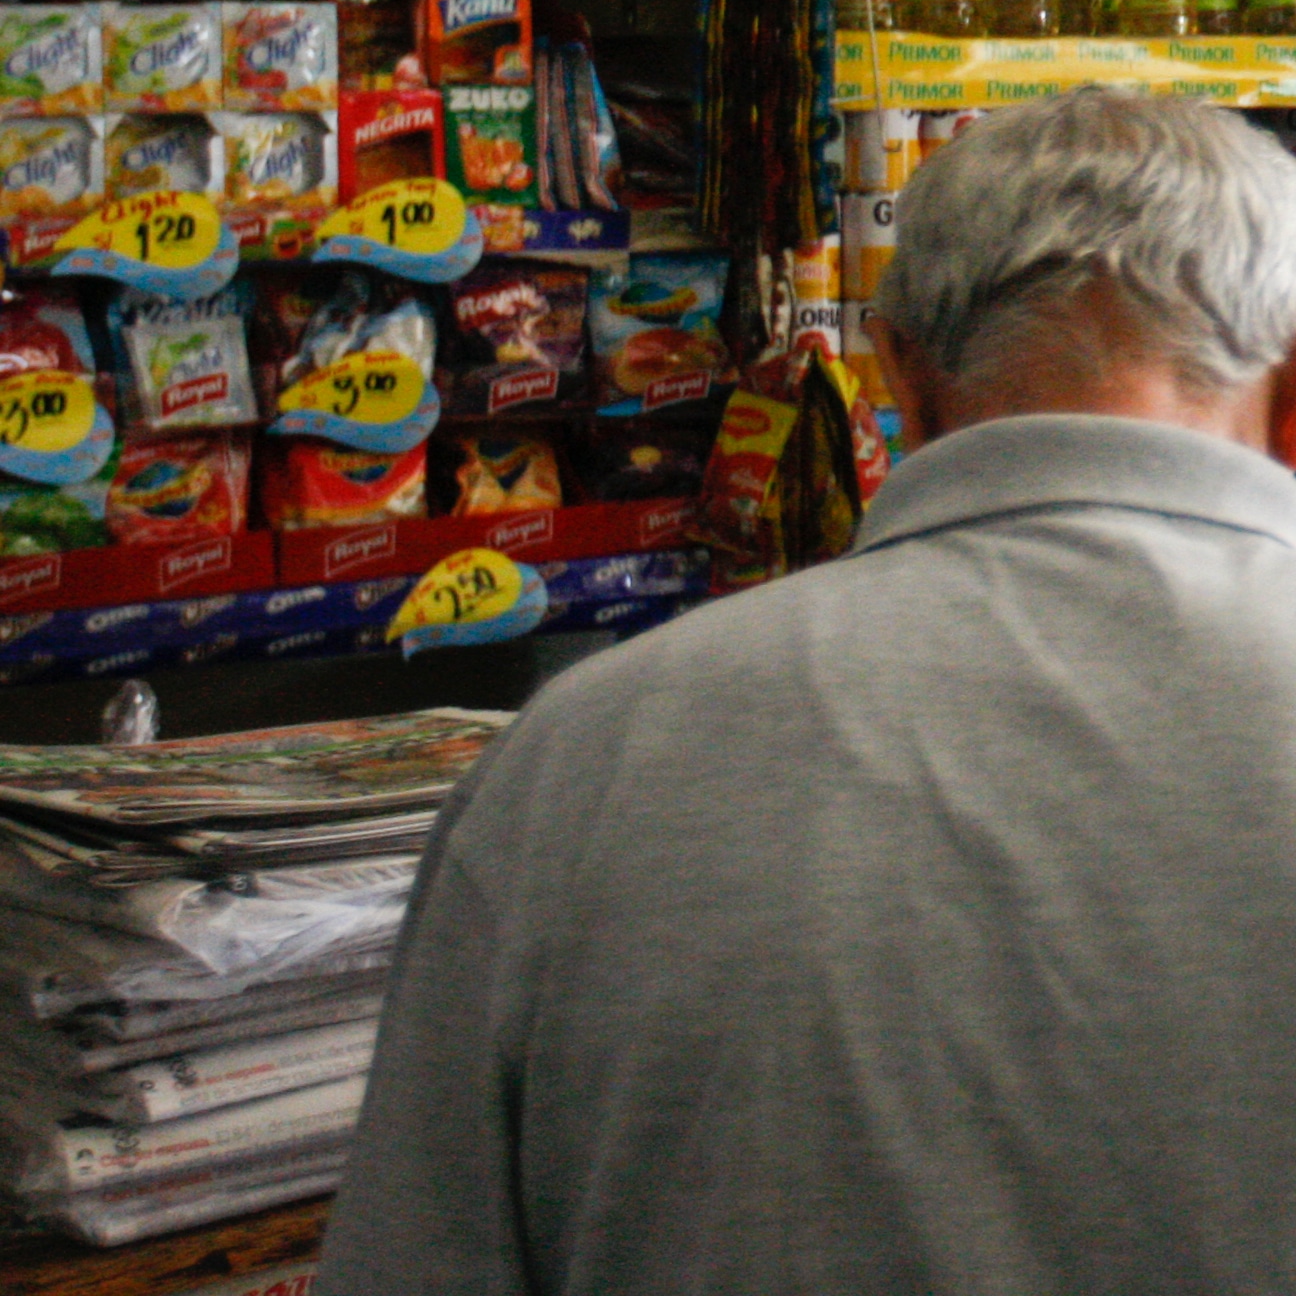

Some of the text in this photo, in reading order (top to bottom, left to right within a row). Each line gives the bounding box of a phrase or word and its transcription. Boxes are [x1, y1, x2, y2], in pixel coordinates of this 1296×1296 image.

[888, 40, 961, 61] PRIMOR
[1168, 41, 1235, 62] PRIMOR
[888, 79, 964, 100] PRIMOR
[987, 80, 1060, 101] PRIMOR
[355, 108, 435, 144] NEGRITA
[167, 378, 223, 407] Royal
[499, 373, 552, 400] Royal
[168, 544, 224, 574] Royal
[335, 531, 389, 561] Royal
